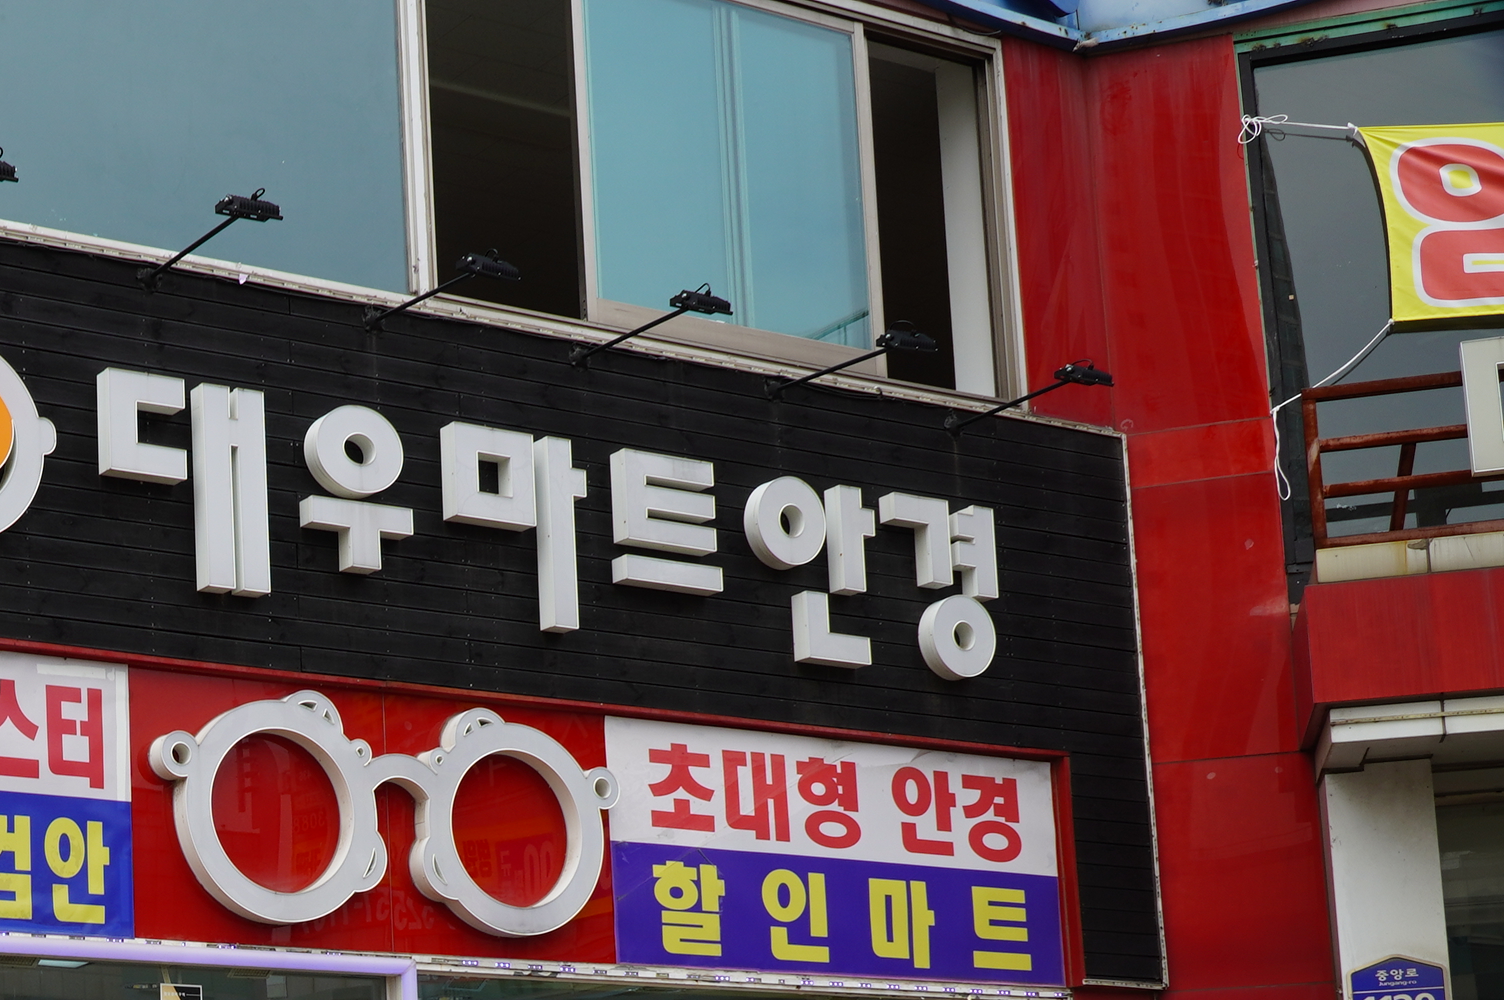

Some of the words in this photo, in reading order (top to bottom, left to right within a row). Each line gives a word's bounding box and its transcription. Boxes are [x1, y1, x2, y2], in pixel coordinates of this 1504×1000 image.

[97, 366, 999, 681] 대우마트안경
[647, 742, 862, 849] 초대형
[891, 766, 1023, 863] 안경
[652, 860, 1032, 971] 할인마트
[1375, 968, 1419, 982] 중앙로
[1378, 979, 1417, 987] Jungang-ro
